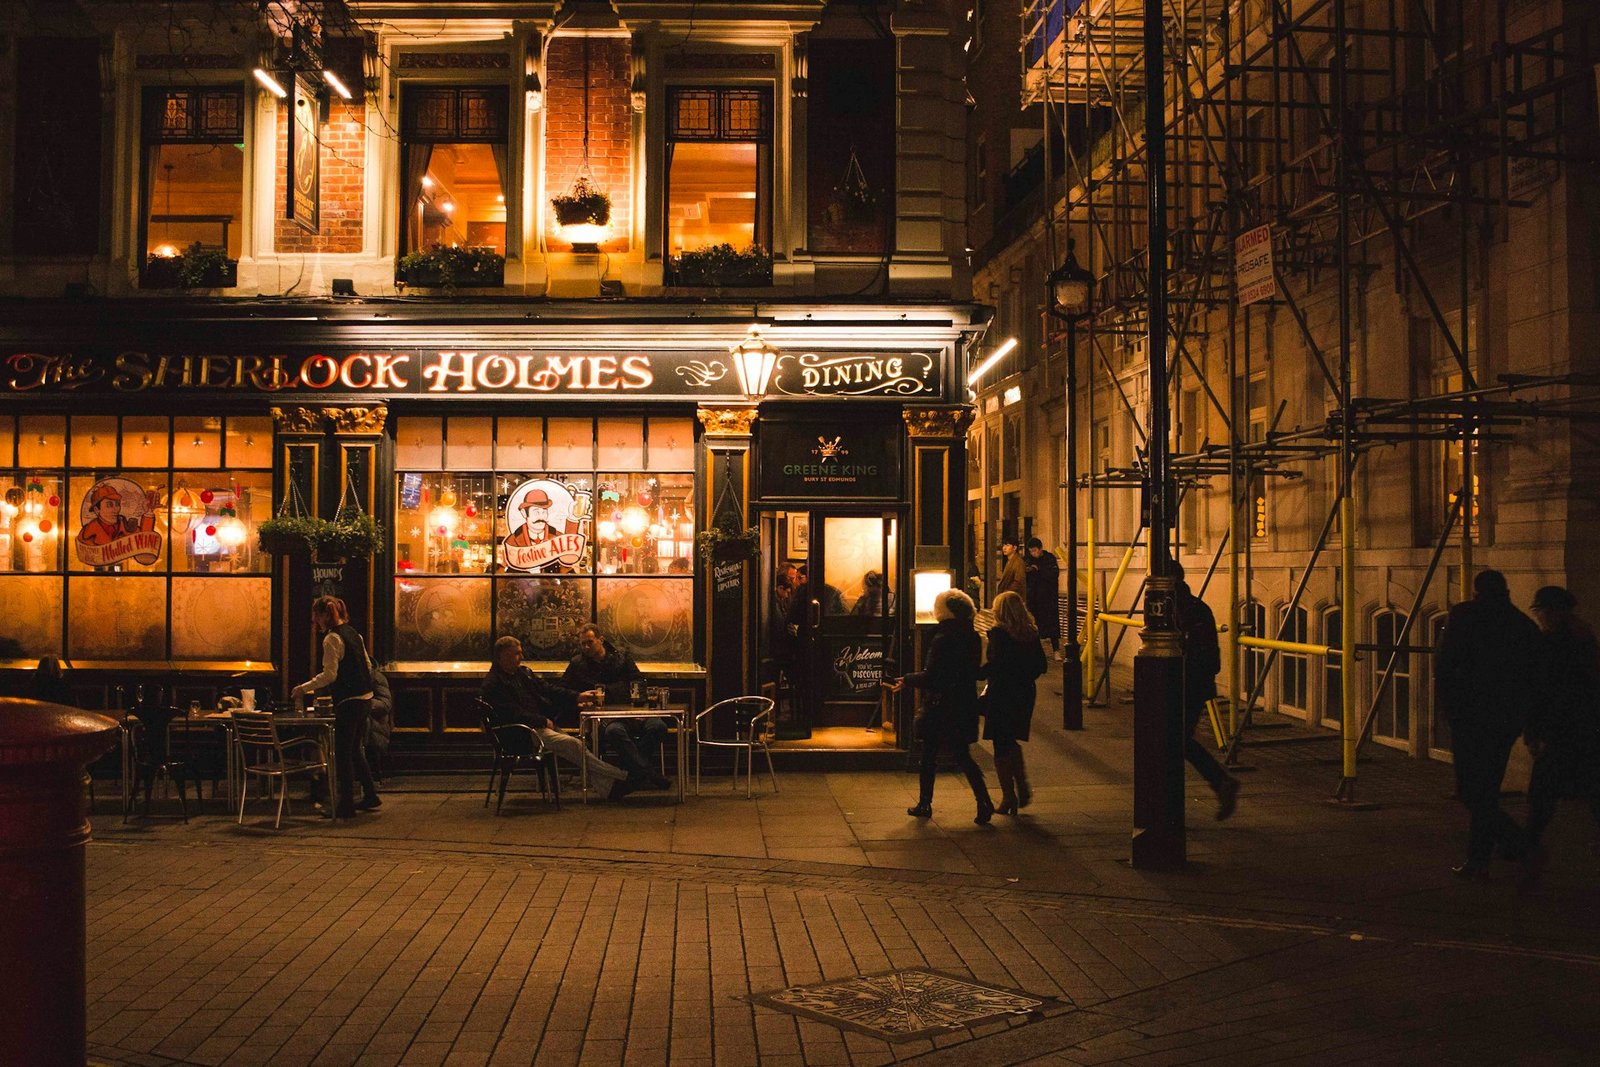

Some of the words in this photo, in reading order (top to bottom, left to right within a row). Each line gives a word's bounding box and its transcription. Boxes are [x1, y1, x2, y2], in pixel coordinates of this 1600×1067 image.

[1238, 254, 1269, 273] PROSAFE
[5, 352, 98, 391] The
[112, 352, 411, 392] SHERLOCK
[423, 351, 654, 392] HOLMES
[802, 357, 904, 388] DINING
[783, 464, 837, 476] GREENE
[842, 465, 878, 476] KING
[101, 538, 133, 562] Mulled
[134, 533, 158, 551] WINE
[549, 535, 581, 557] ALES
[313, 567, 343, 582] HOUNDS
[840, 646, 883, 664] Welcom
